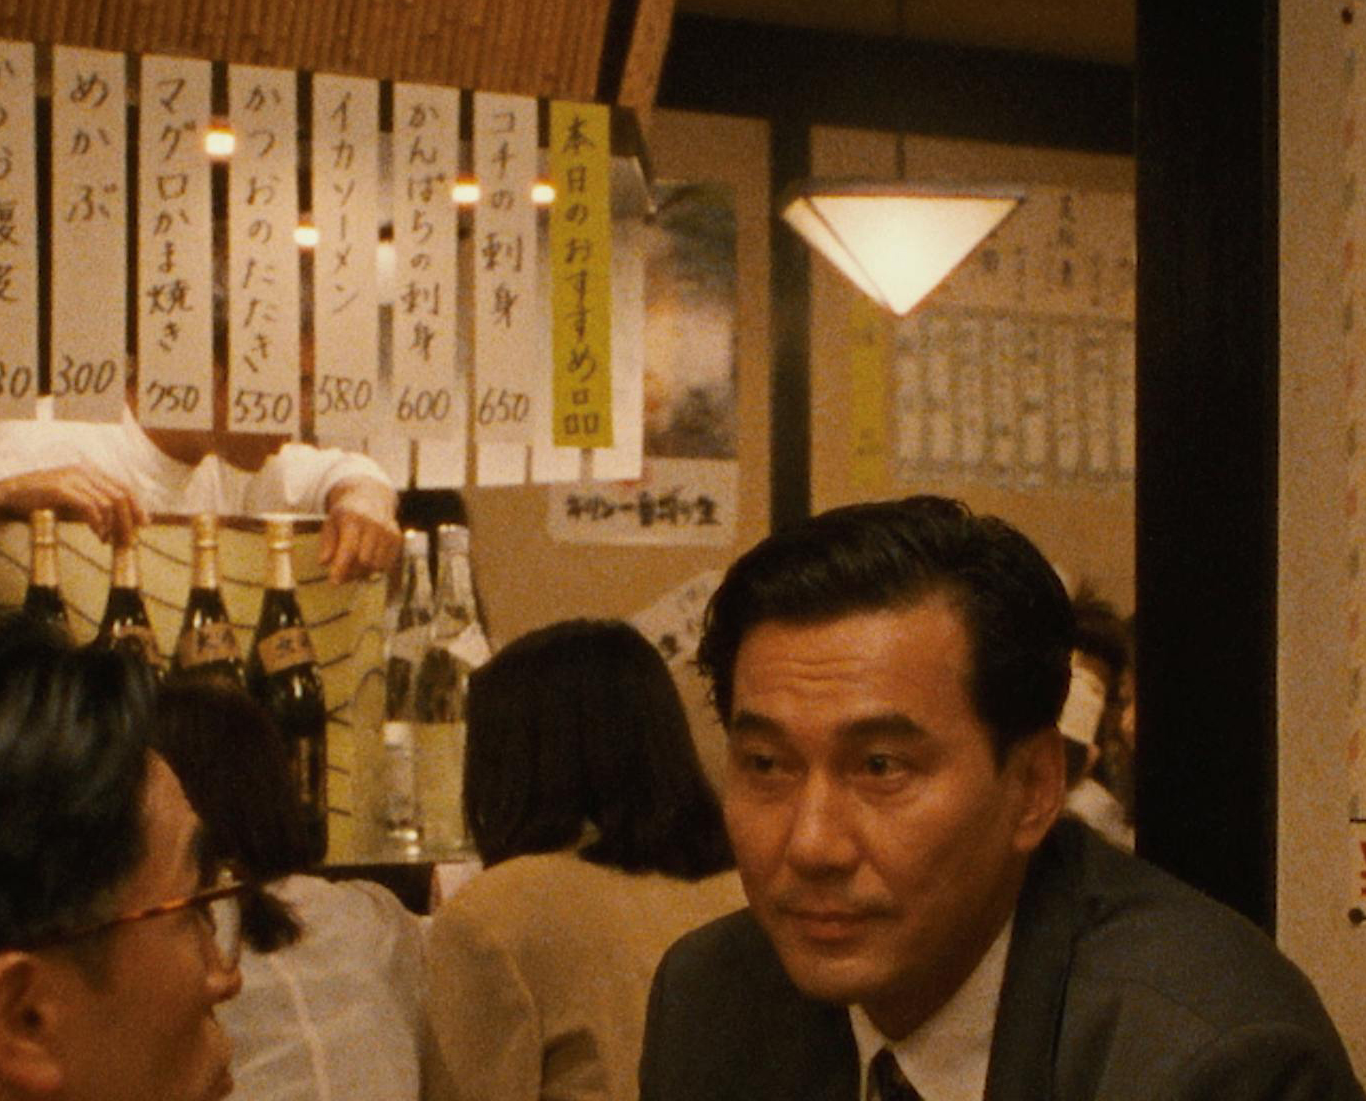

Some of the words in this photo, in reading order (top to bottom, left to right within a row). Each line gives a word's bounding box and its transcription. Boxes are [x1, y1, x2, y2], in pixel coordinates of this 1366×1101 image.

[65, 70, 113, 223] めかぶ
[146, 77, 197, 352] マグロかま焼き
[242, 83, 282, 374] かつおのたたき
[330, 91, 359, 315] イカソーメン
[482, 110, 524, 330] コチの刺身
[560, 113, 600, 437] 本日のおすすめ品
[55, 354, 118, 398] 300
[145, 379, 200, 414] 750
[233, 387, 294, 425] 550
[318, 373, 373, 416] 580
[395, 384, 452, 423] 600
[477, 386, 531, 427] 650
